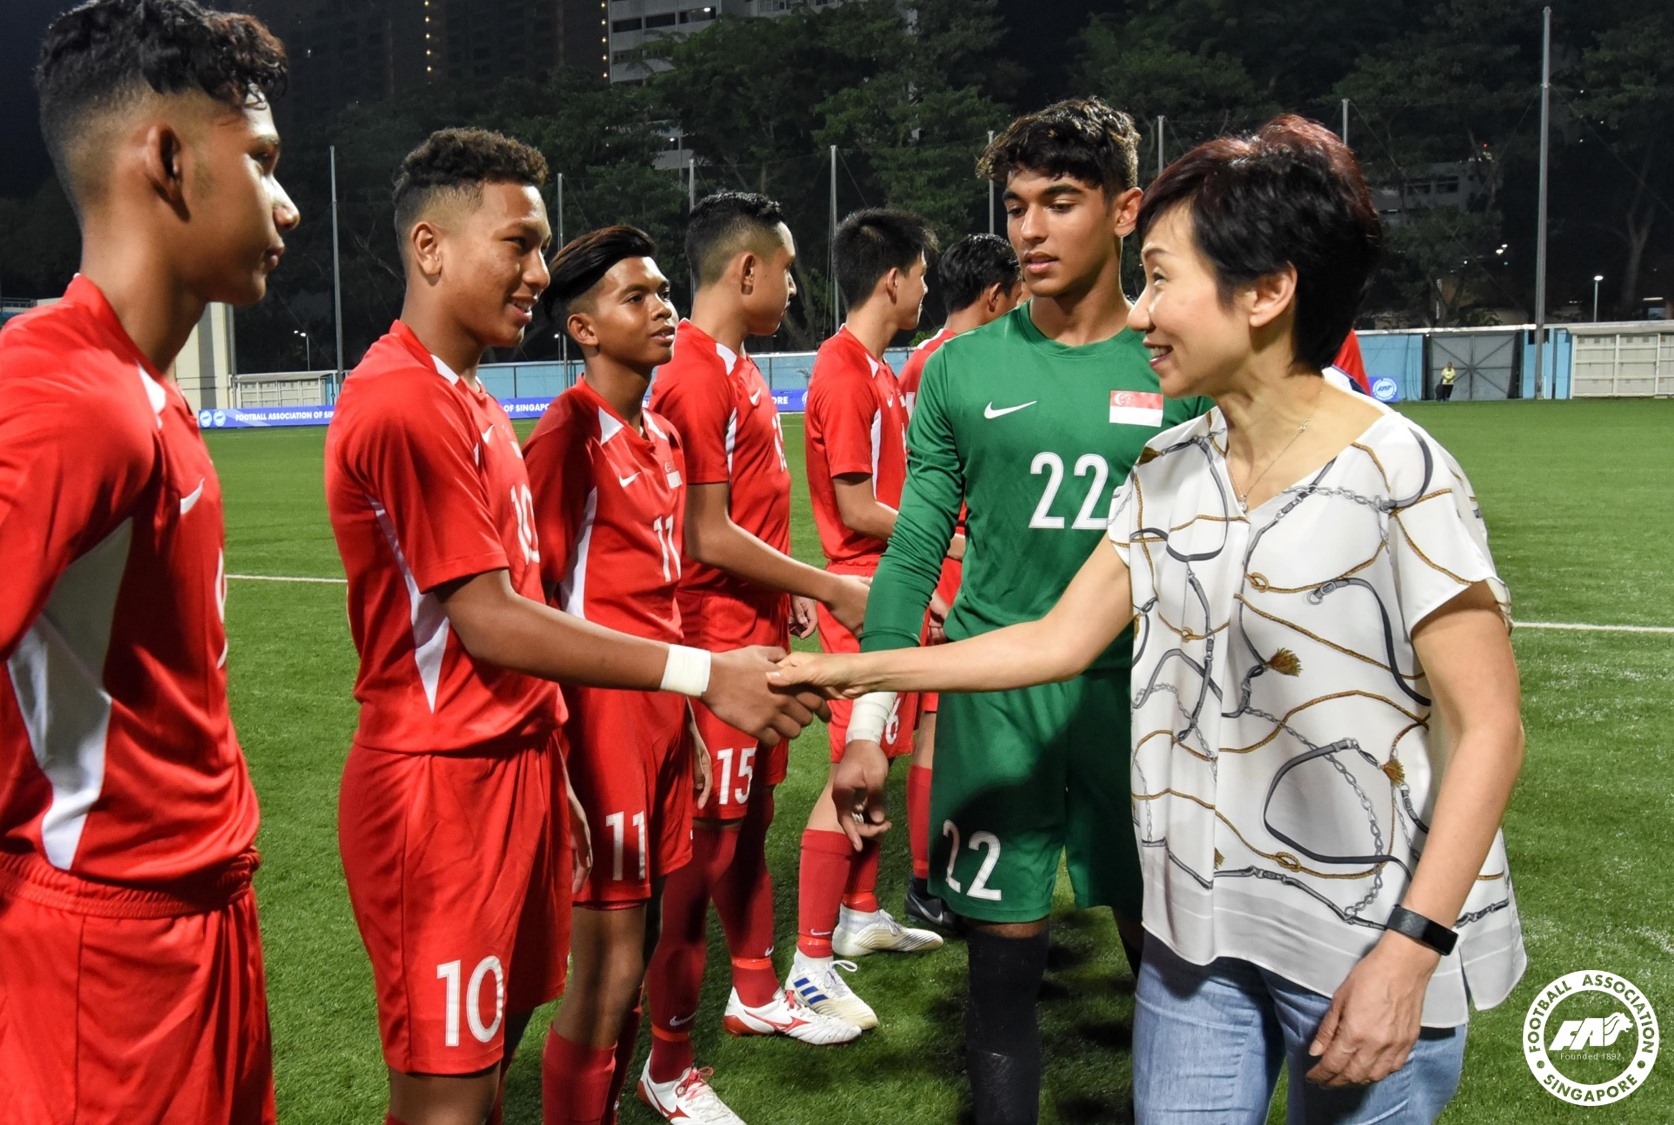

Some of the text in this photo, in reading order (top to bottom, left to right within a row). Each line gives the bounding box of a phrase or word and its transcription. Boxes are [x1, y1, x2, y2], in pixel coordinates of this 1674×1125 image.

[235, 412, 267, 421] FOOTBALL
[268, 411, 312, 420] ASSOCIATION
[313, 411, 323, 419] OF
[503, 404, 514, 412] OF
[1028, 451, 1109, 529] 22
[653, 514, 682, 582] 11
[717, 748, 756, 805] 15
[606, 810, 646, 881] 11
[943, 819, 1002, 901] 22
[436, 955, 504, 1047] 10
